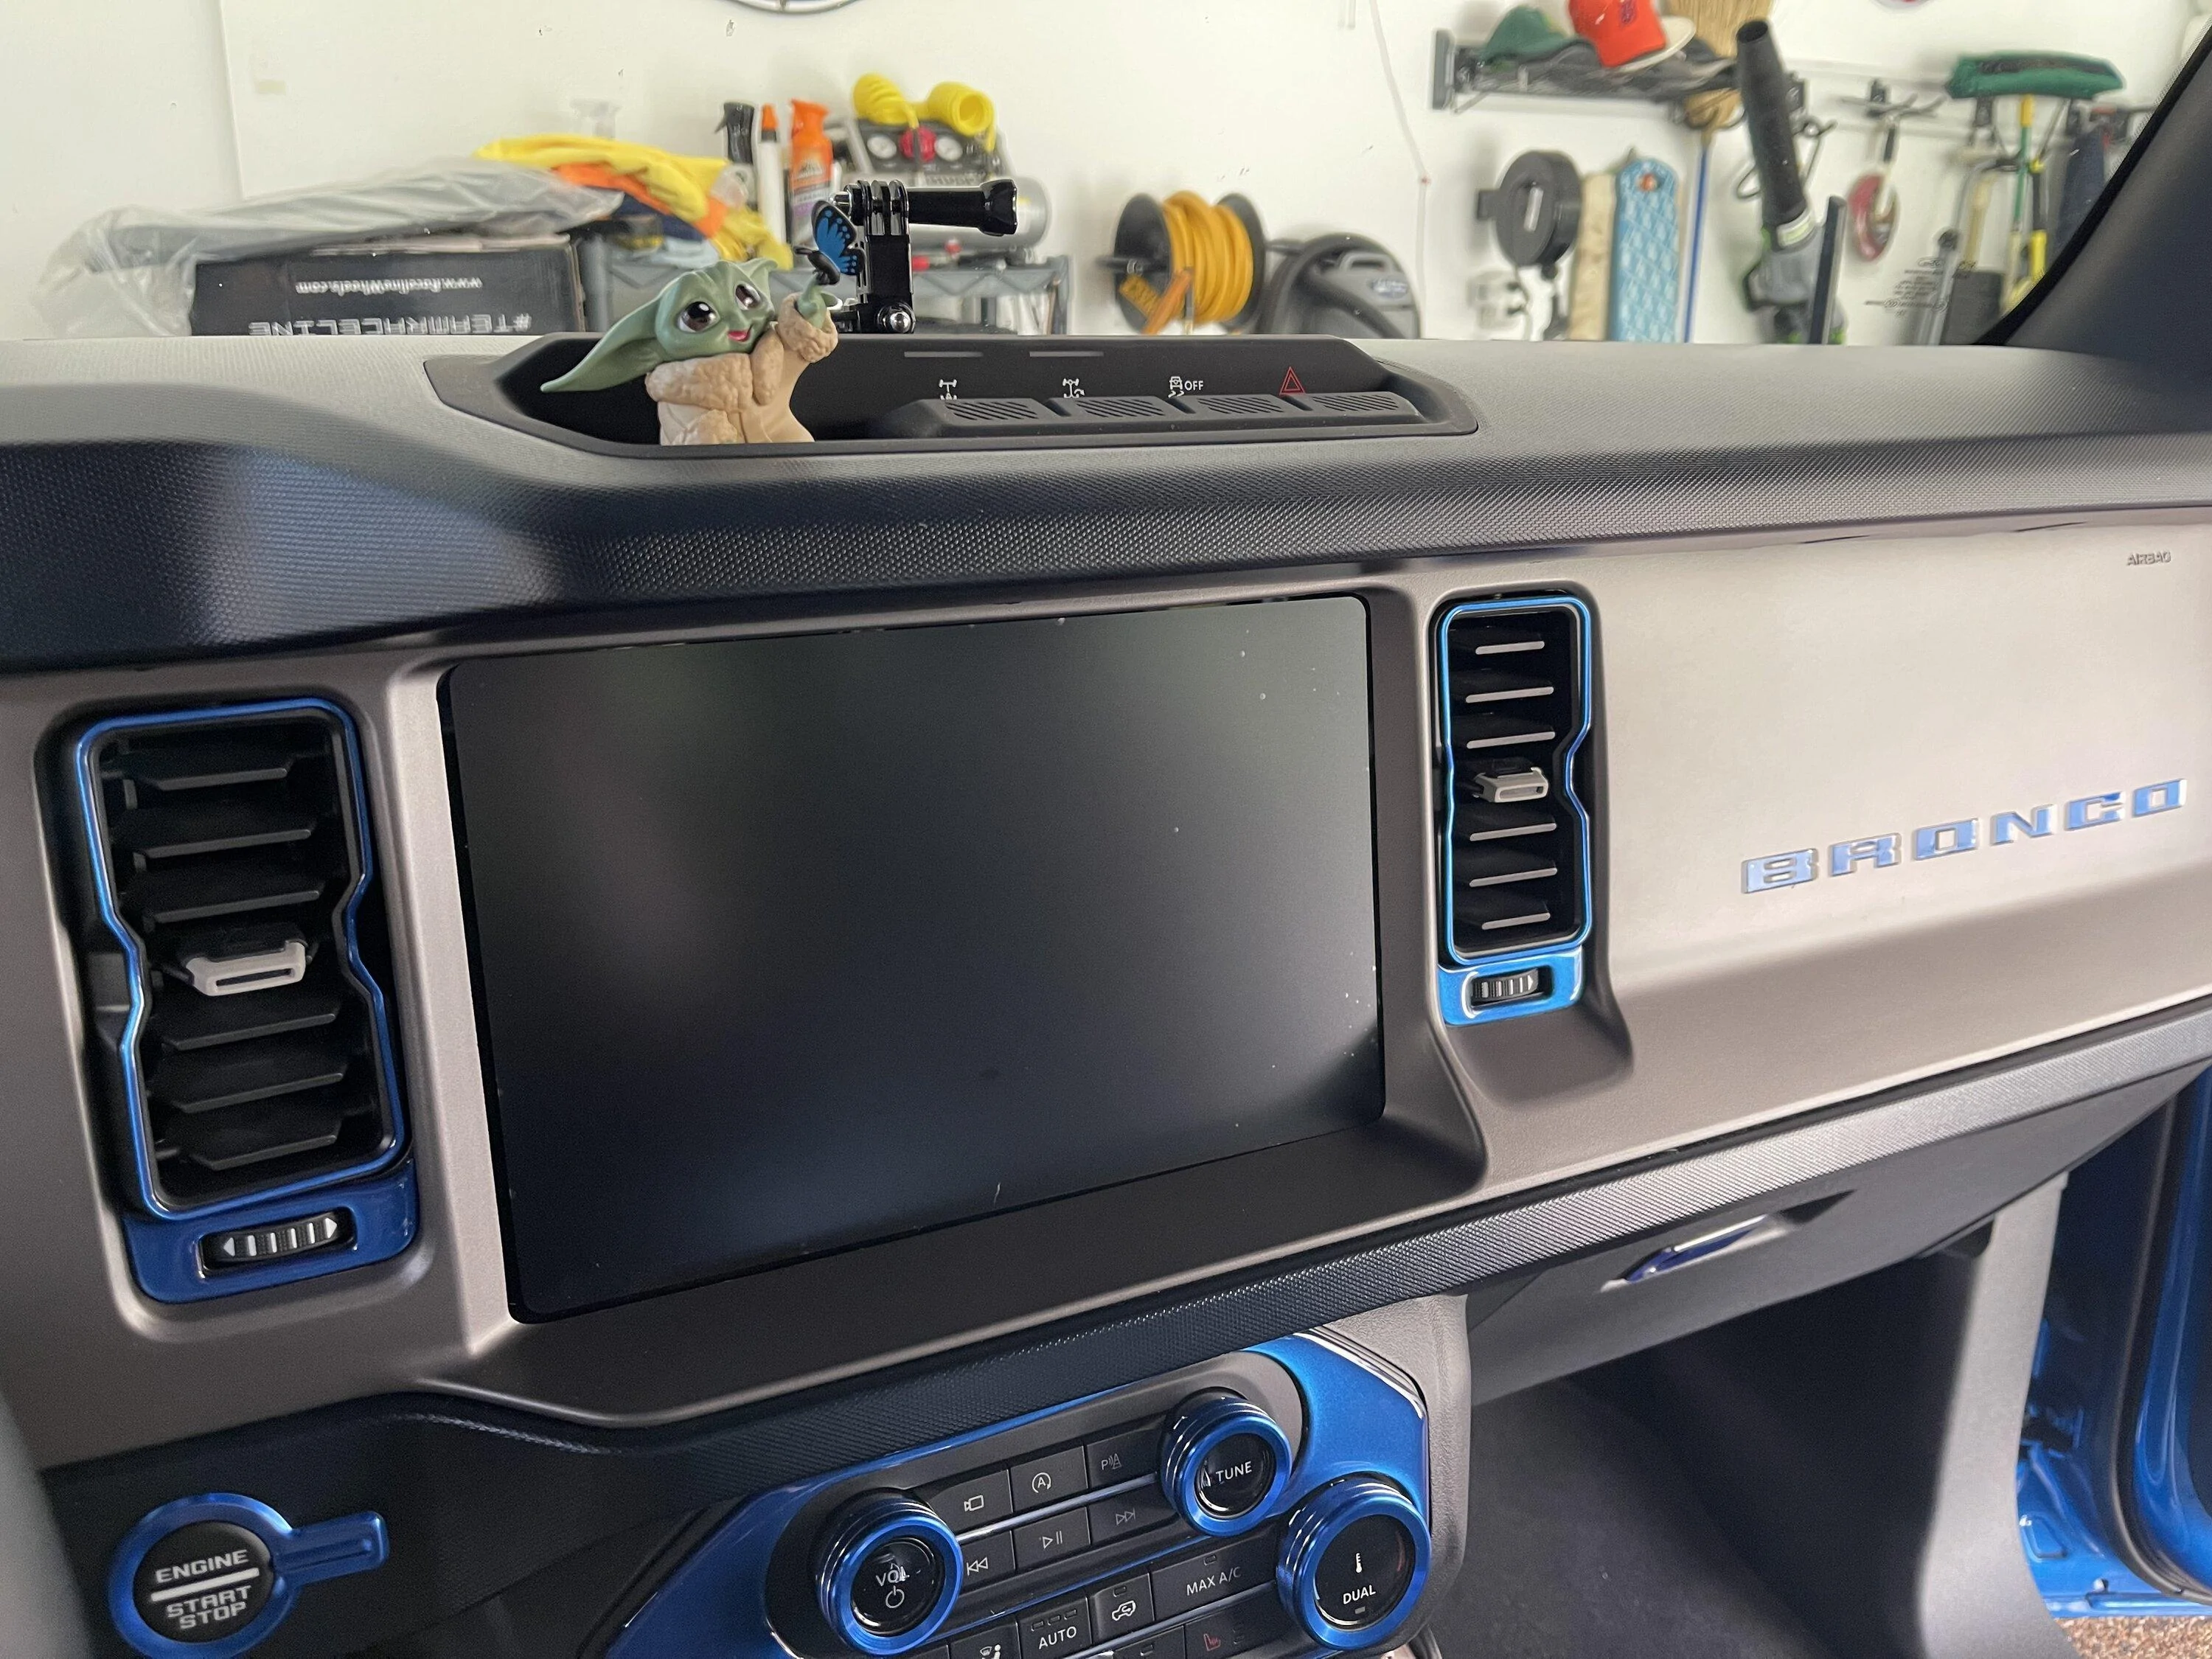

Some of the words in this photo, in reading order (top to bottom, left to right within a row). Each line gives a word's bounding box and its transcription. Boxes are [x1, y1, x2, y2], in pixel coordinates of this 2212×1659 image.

[248, 313, 532, 335] #TEAMRACELINE
[1184, 380, 1204, 391] OFF
[2126, 551, 2171, 566] AIRBAG
[1741, 778, 2188, 894] BRONCO
[1216, 1461, 1252, 1482] TUNE
[156, 1549, 249, 1583] ENGINE
[1186, 1575, 1216, 1596] MAX
[1219, 1566, 1242, 1585] A/C
[167, 1585, 251, 1618] START
[1343, 1585, 1377, 1604] DUAL
[179, 1601, 247, 1630] STOP
[1038, 1626, 1077, 1650] AUTO
